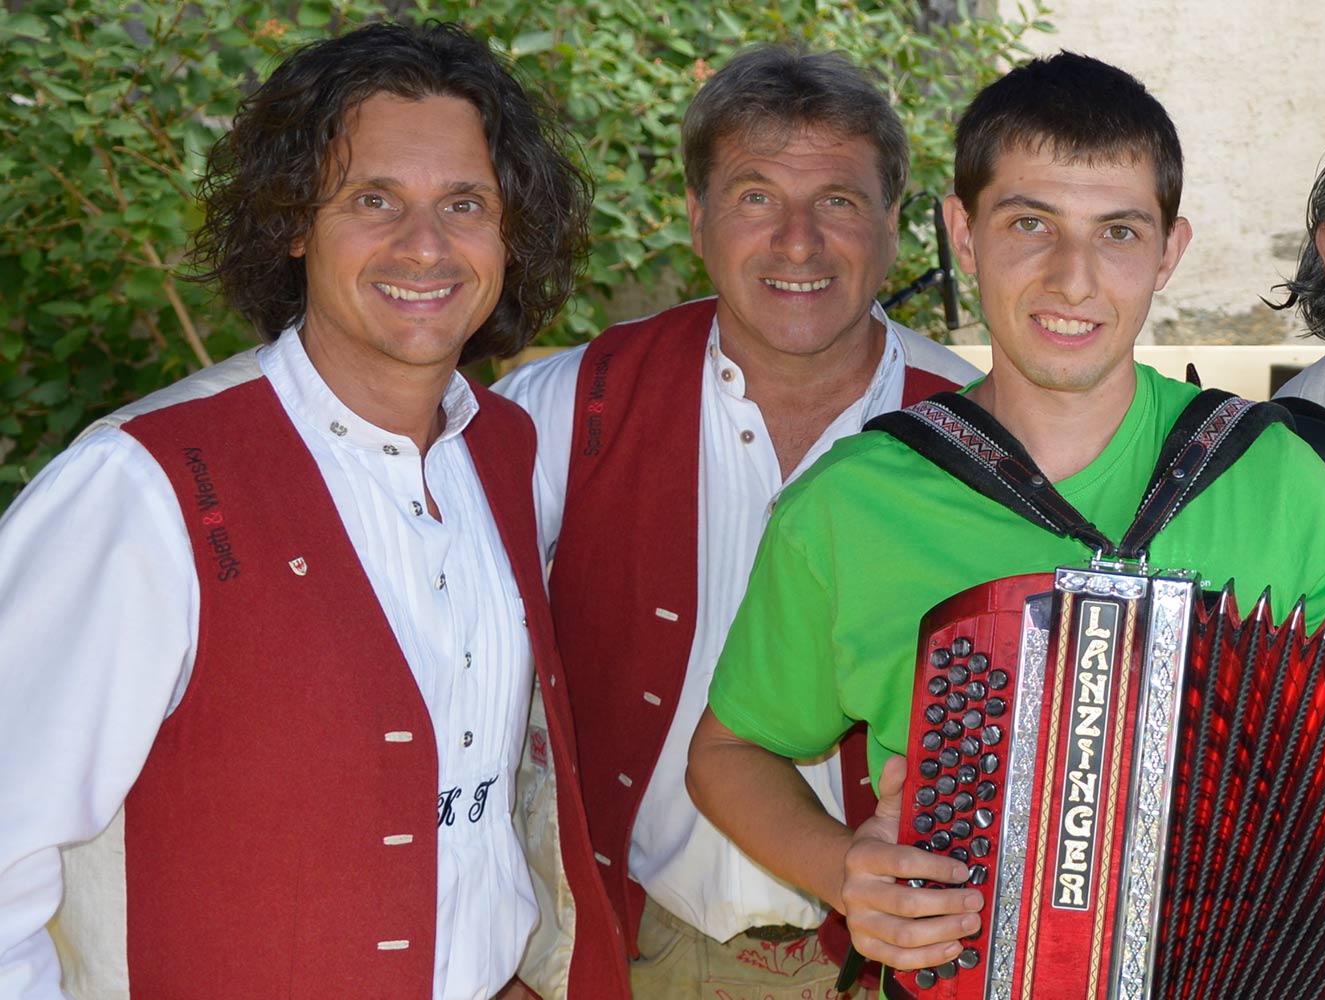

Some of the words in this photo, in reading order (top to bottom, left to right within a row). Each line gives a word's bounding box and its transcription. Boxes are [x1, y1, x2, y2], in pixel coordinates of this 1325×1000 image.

[588, 401, 605, 413] &
[183, 447, 219, 512] Wensky
[203, 512, 224, 525] &
[207, 526, 240, 582] Spieth
[1058, 606, 1111, 906] LANZINGER
[437, 786, 462, 828] K
